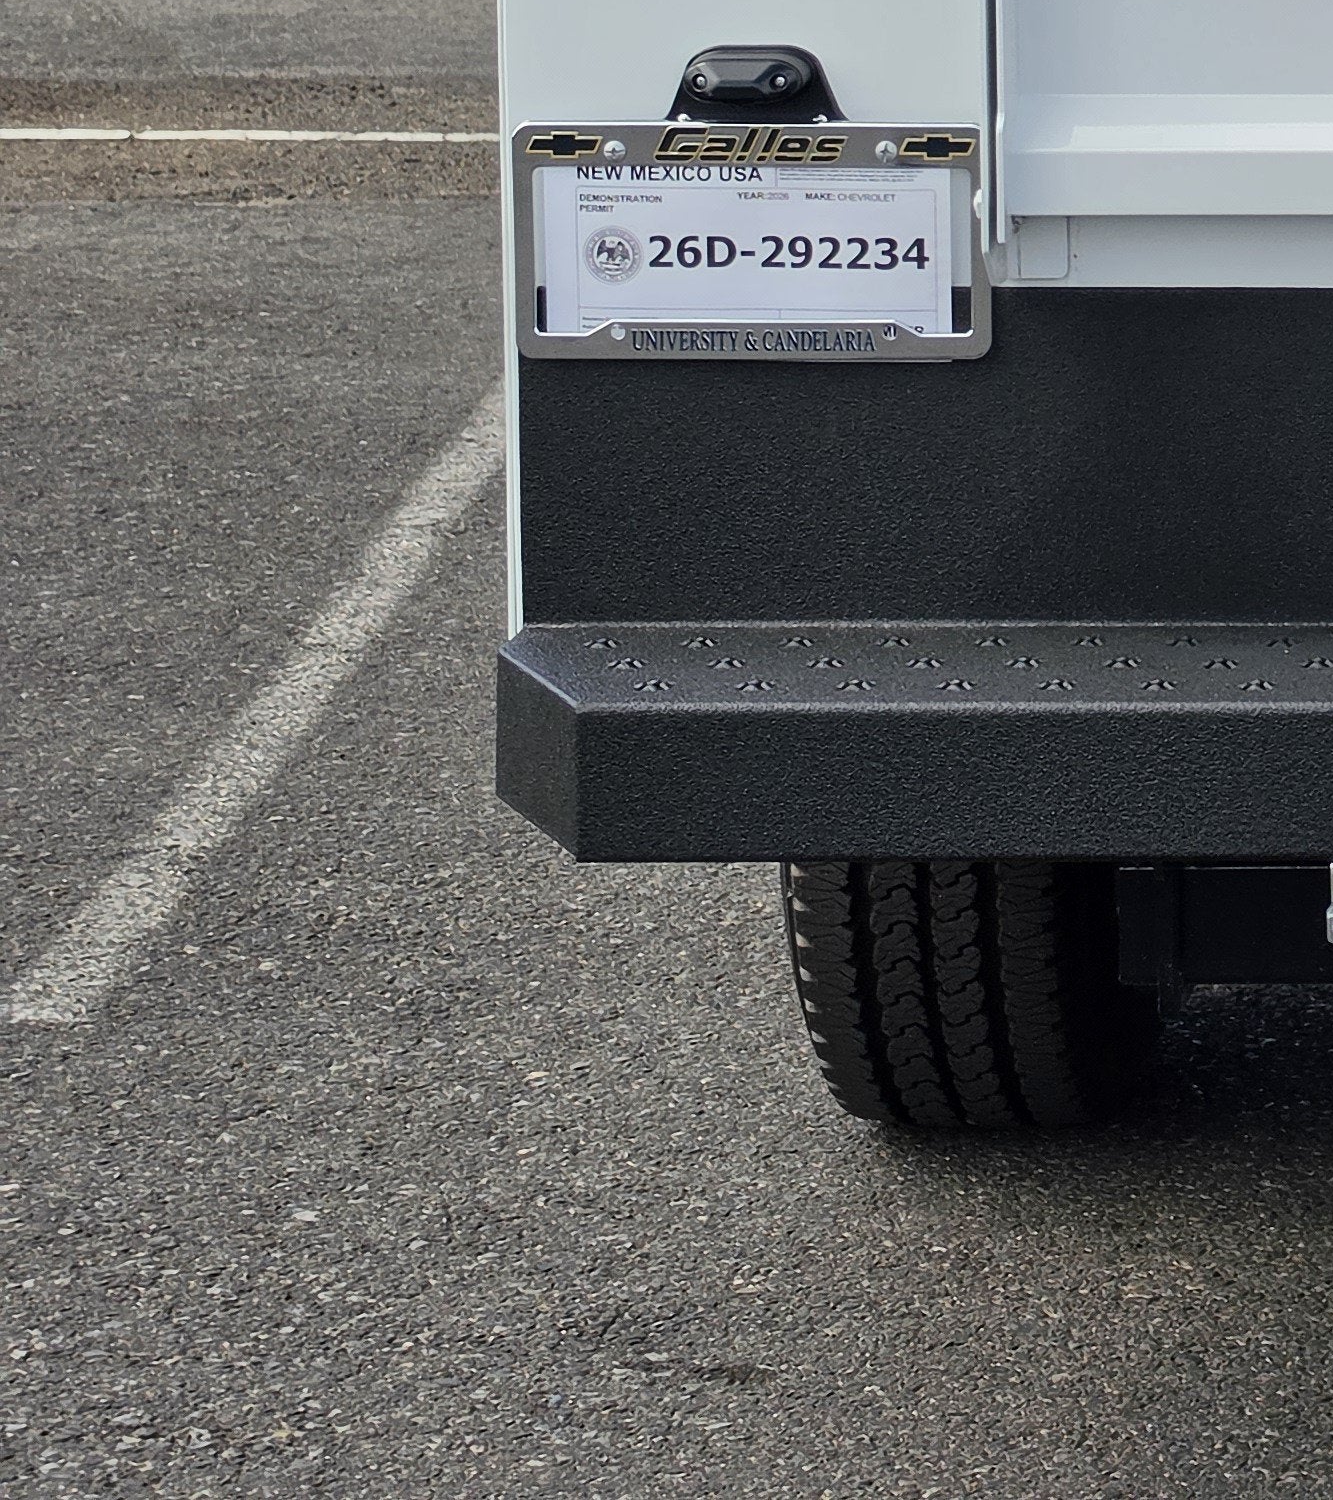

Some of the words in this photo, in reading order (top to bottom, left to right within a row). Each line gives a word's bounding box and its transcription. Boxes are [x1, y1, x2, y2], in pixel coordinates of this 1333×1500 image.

[654, 126, 848, 164] Galles
[576, 166, 622, 180] NEW
[631, 166, 711, 182] MEXICO
[719, 167, 762, 182] USA
[579, 193, 663, 203] DEMONSTRATION
[837, 193, 896, 202] CHEVROLET
[579, 204, 614, 213] PERMIT
[648, 235, 930, 270] 26D-292234
[631, 328, 739, 352] UNIVERSITY
[744, 330, 759, 352] &
[762, 329, 878, 352] CANDELARIA
